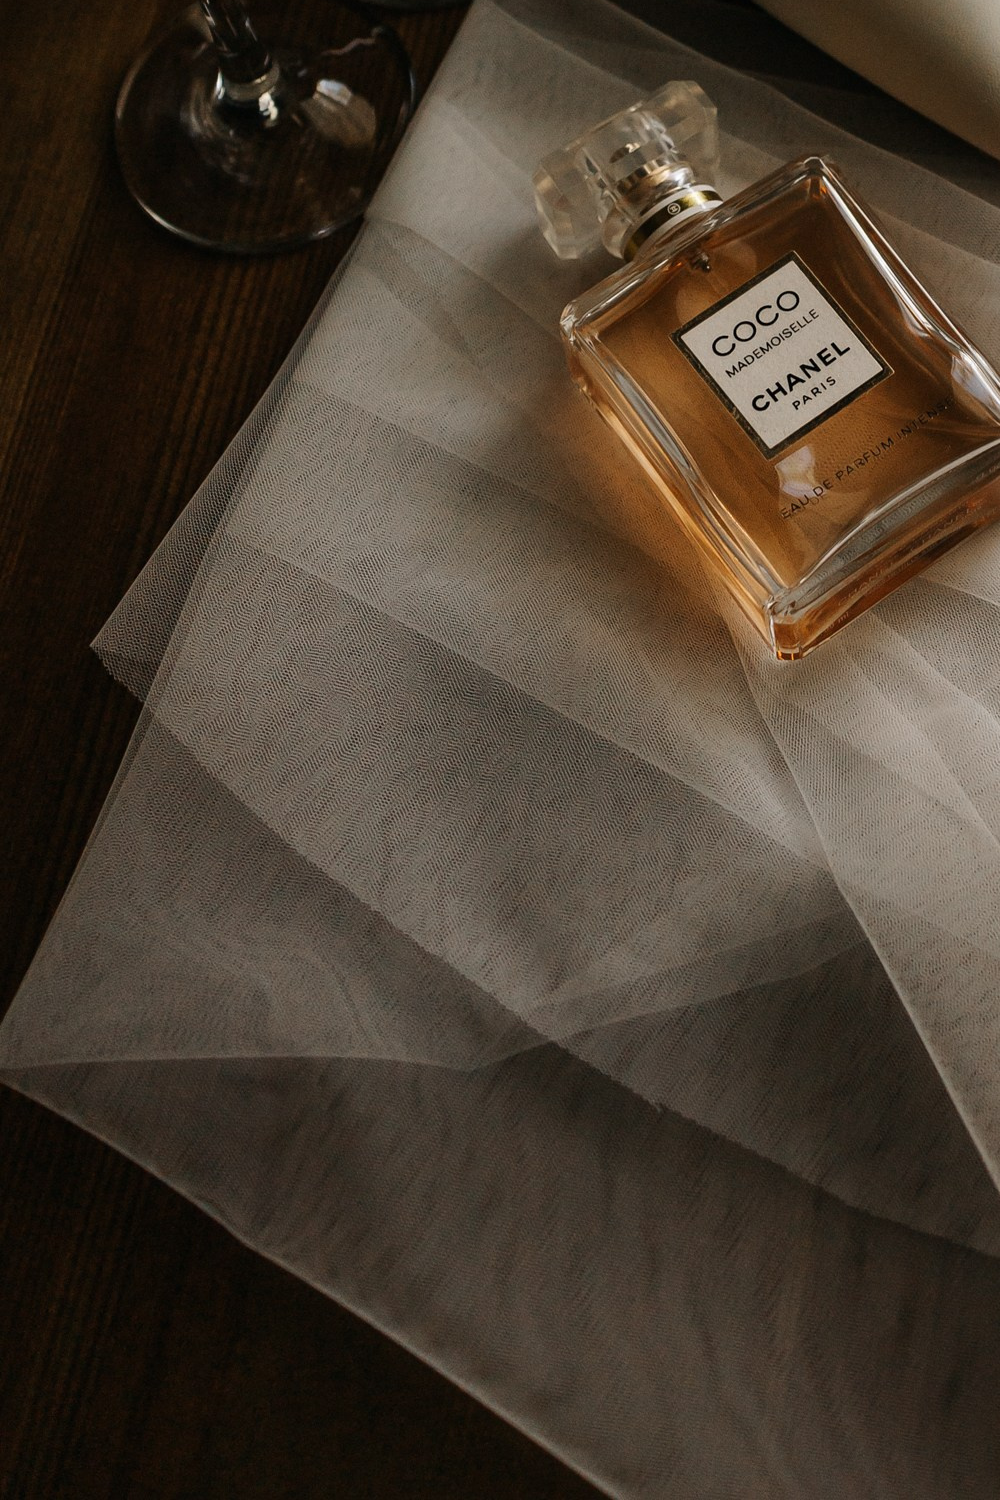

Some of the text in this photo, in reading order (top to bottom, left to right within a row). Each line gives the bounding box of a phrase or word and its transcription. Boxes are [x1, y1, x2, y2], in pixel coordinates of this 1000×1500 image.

[711, 290, 800, 357] COCO
[725, 308, 820, 378] MADEMOISELLE
[751, 341, 851, 412] CHANEL
[791, 376, 837, 410] PARIS
[780, 494, 810, 520] EAU
[812, 479, 834, 497] DE
[835, 437, 894, 482] PARFUM
